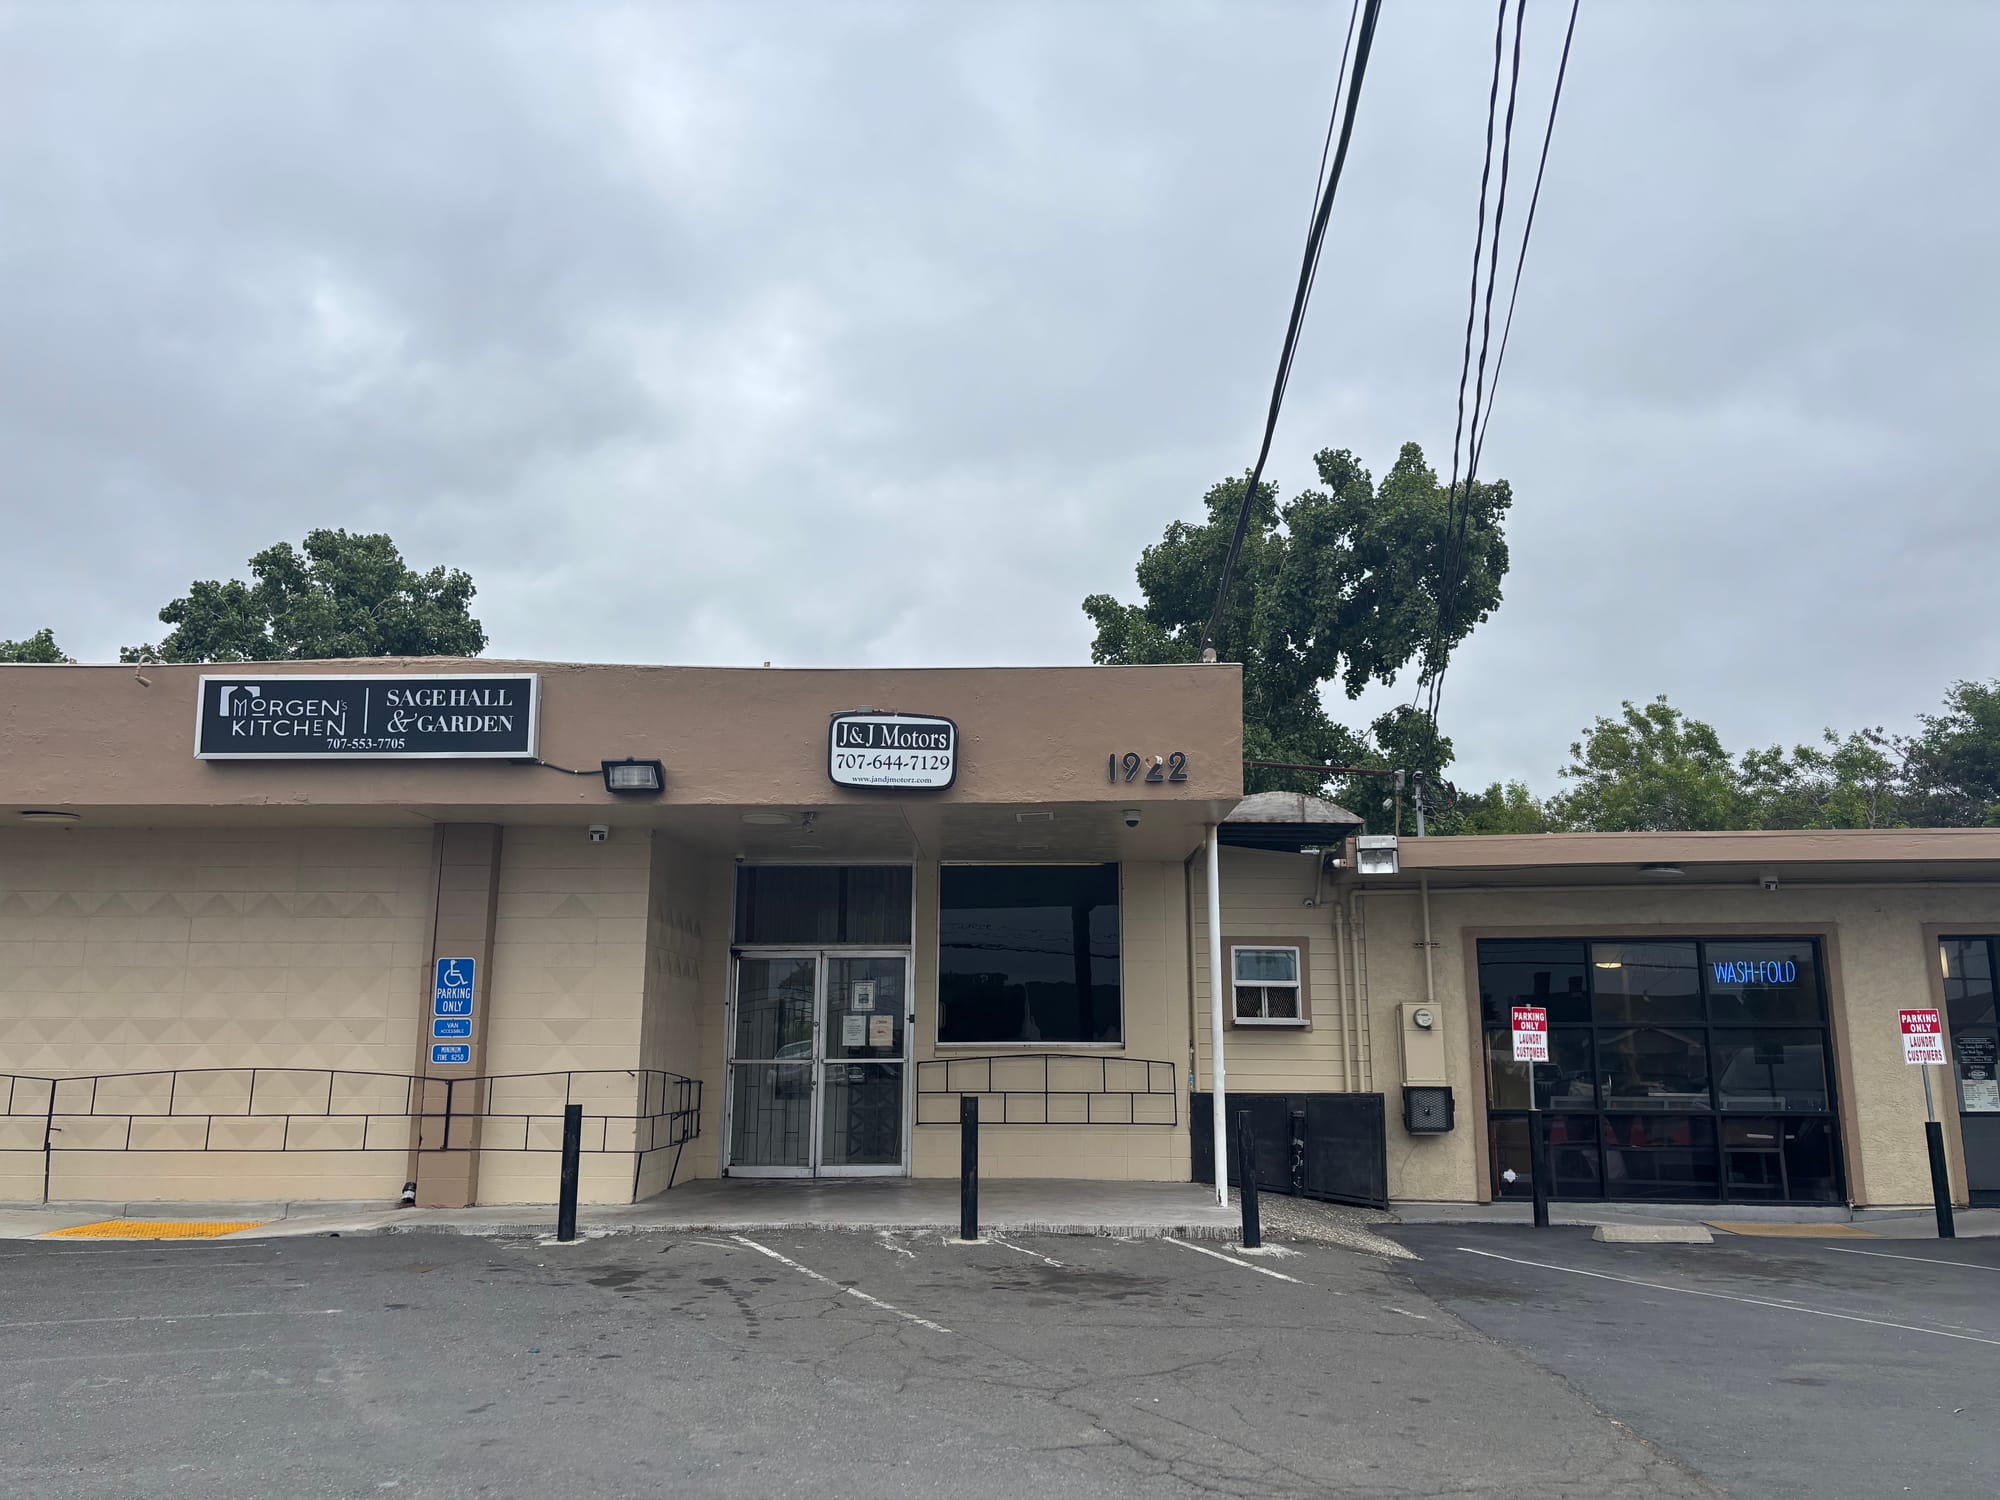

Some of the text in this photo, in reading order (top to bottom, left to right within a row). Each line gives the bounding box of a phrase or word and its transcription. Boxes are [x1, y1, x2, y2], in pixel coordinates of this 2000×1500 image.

[232, 712, 346, 736] KITCHEN
[840, 723, 947, 748] J&J Motors
[327, 738, 405, 749] 707-553-7705
[836, 754, 950, 770] 707-644-7129
[1108, 751, 1188, 783] 1922
[1713, 960, 1796, 984] WASH-FOLD
[437, 987, 471, 999] PARKING
[442, 1001, 463, 1012] ONLY
[1513, 1011, 1545, 1022] PARKING
[1901, 1014, 1937, 1023] PARKING
[1520, 1021, 1539, 1030] ONLY
[1910, 1023, 1931, 1033] ONLY
[1519, 1033, 1542, 1045] LAUNDRY
[1910, 1036, 1935, 1047] LAUNDRY
[1516, 1046, 1546, 1059] CUSTOMERS
[1907, 1050, 1943, 1061] CUSTOMERS
